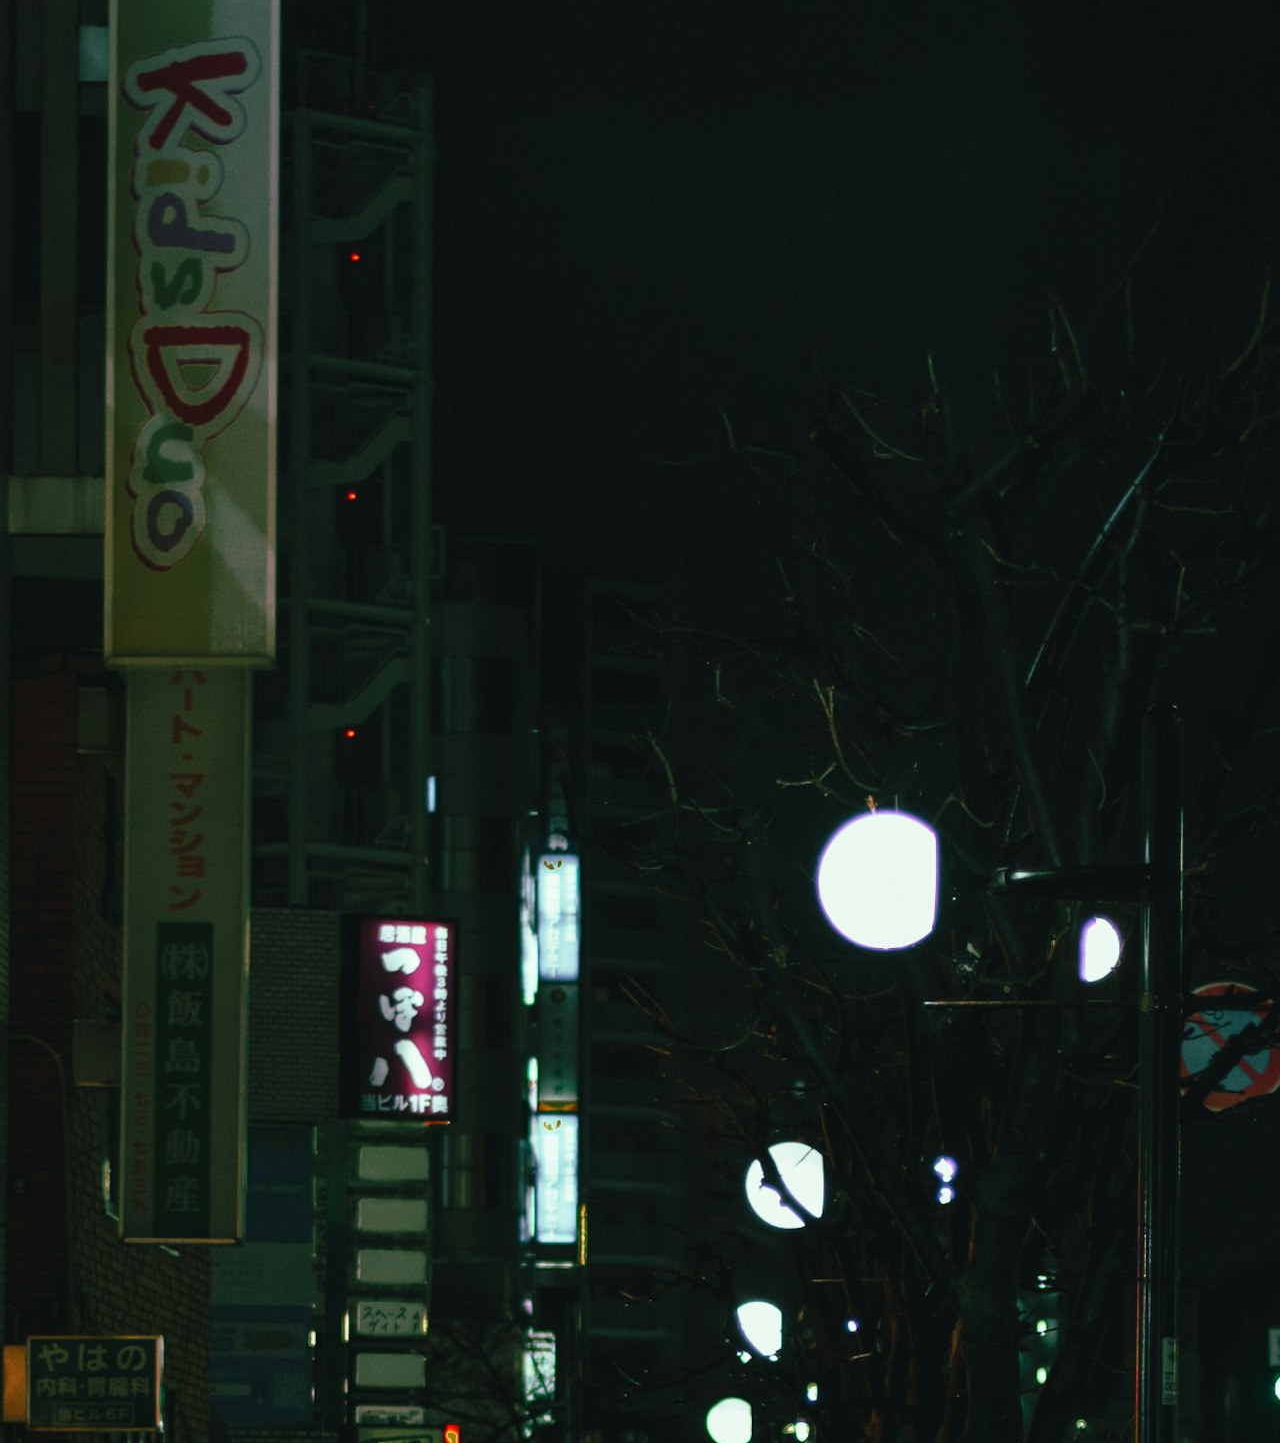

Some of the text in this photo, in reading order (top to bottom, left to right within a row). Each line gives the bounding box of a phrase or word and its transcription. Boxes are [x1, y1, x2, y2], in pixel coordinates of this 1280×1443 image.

[136, 50, 250, 553] KidsDuo
[370, 947, 433, 1085] つぼ八
[37, 1342, 148, 1372] やはの
